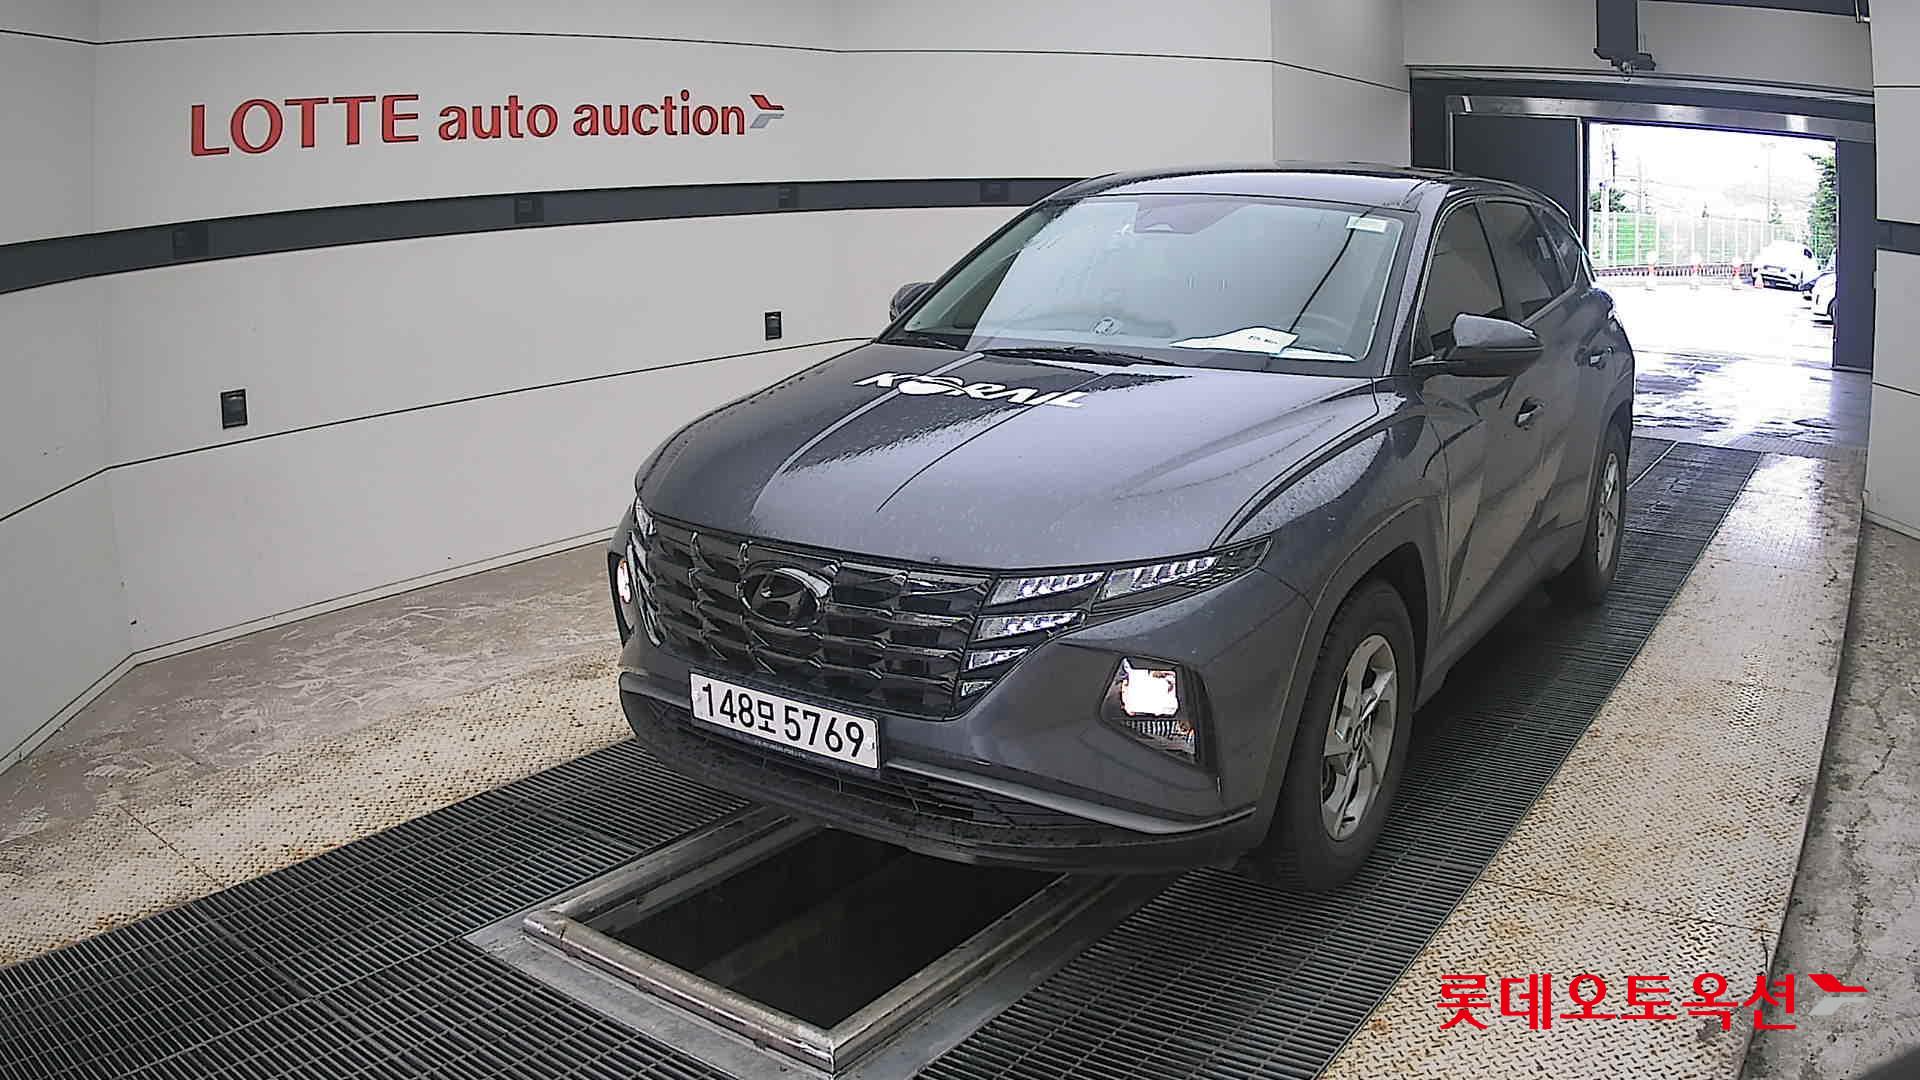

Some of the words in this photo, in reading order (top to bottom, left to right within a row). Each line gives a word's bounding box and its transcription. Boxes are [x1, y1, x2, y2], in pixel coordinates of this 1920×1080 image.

[191, 94, 419, 157] LOTTE
[438, 95, 559, 140] auto
[573, 90, 746, 136] auction
[701, 682, 777, 735] 148모
[783, 704, 865, 758] 5769
